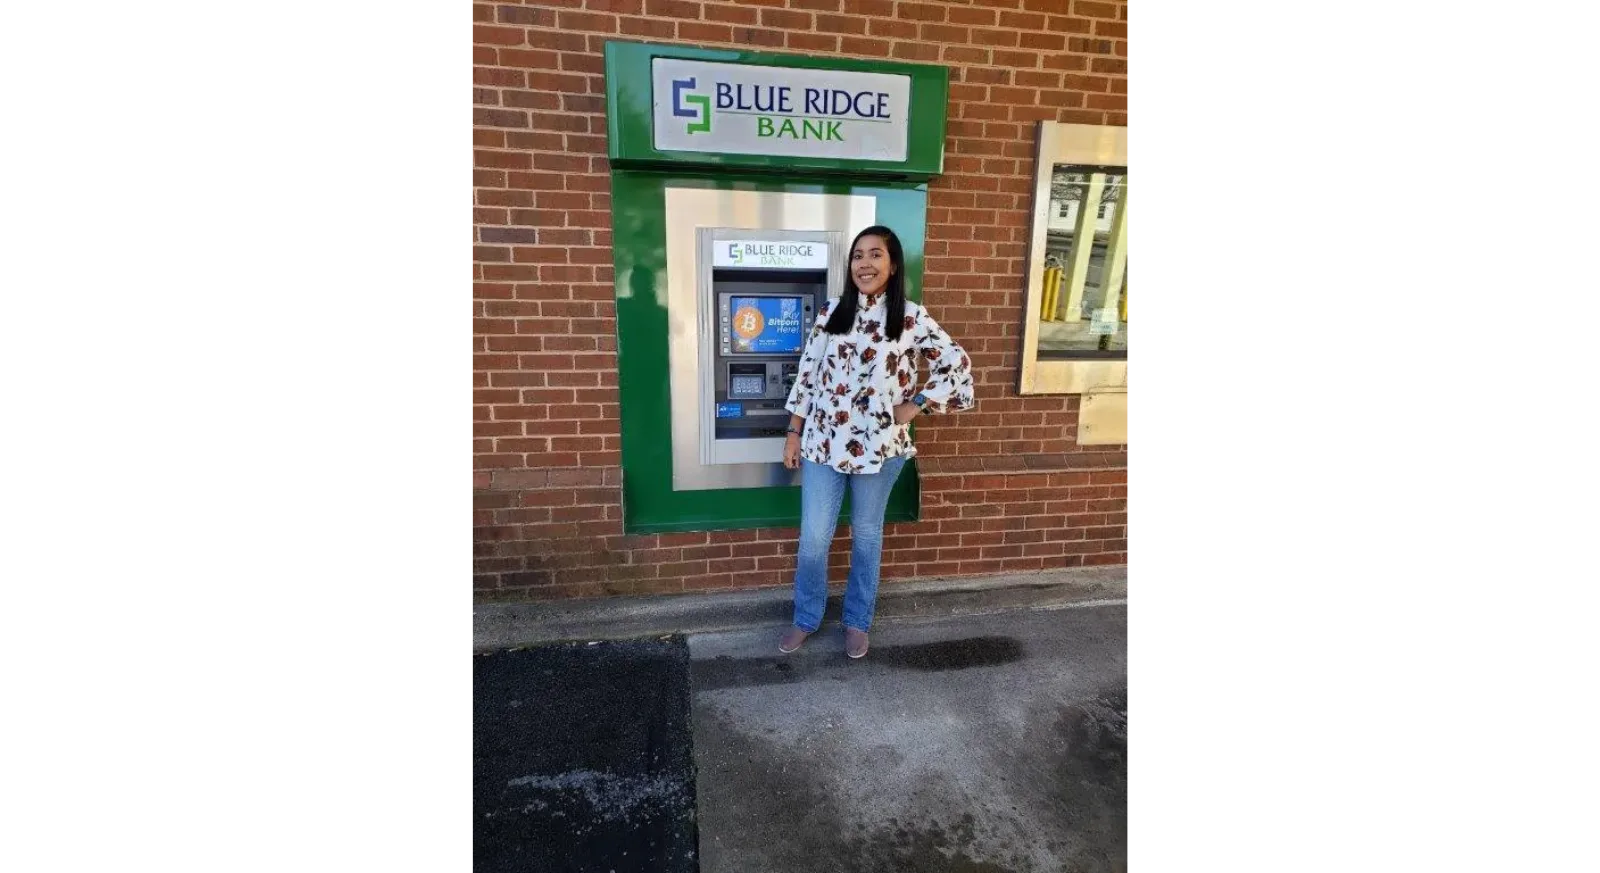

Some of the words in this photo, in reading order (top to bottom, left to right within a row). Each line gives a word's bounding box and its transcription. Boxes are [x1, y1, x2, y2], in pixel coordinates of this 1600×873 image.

[716, 82, 793, 112] BLUE
[804, 88, 891, 118] RIDGE
[757, 117, 844, 141] BANK
[745, 244, 775, 256] BLUE
[779, 245, 813, 256] RIDGE
[760, 257, 795, 265] BANK
